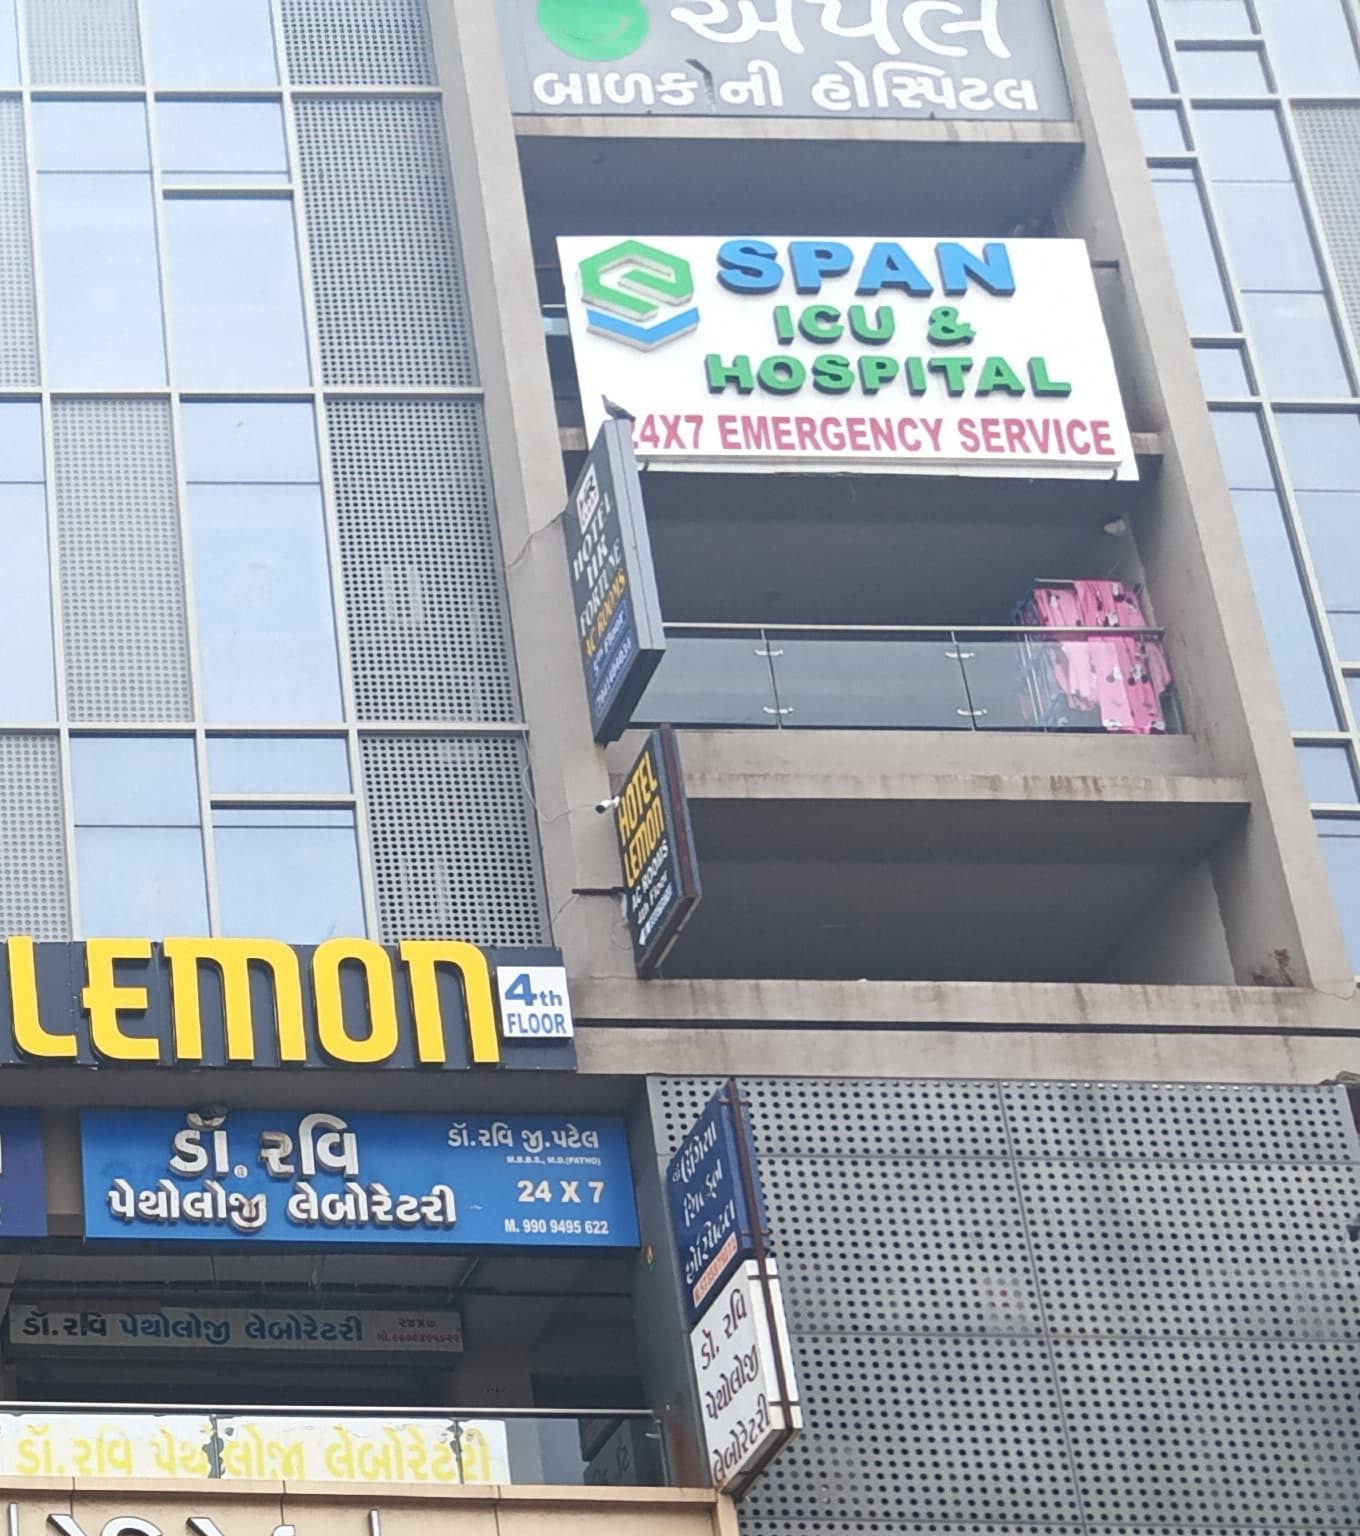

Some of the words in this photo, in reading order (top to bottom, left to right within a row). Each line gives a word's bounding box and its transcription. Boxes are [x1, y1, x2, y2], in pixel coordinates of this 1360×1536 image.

[811, 59, 1039, 110] હોસ્પિટલ
[715, 239, 1016, 296] SPAN
[773, 304, 897, 345] ICU
[928, 307, 978, 345] &
[704, 353, 1072, 397] HOSPITAL
[719, 415, 944, 454] EMERGENCY
[959, 418, 1115, 456] SERVICE
[9, 935, 501, 1064] LEMON
[506, 1012, 566, 1036] FLOOR
[517, 1180, 552, 1203] 24
[560, 1181, 581, 1203] X
[588, 1181, 605, 1203] 7
[523, 1219, 547, 1233] 990
[550, 1220, 581, 1233] 9495
[585, 1221, 609, 1234] 622
